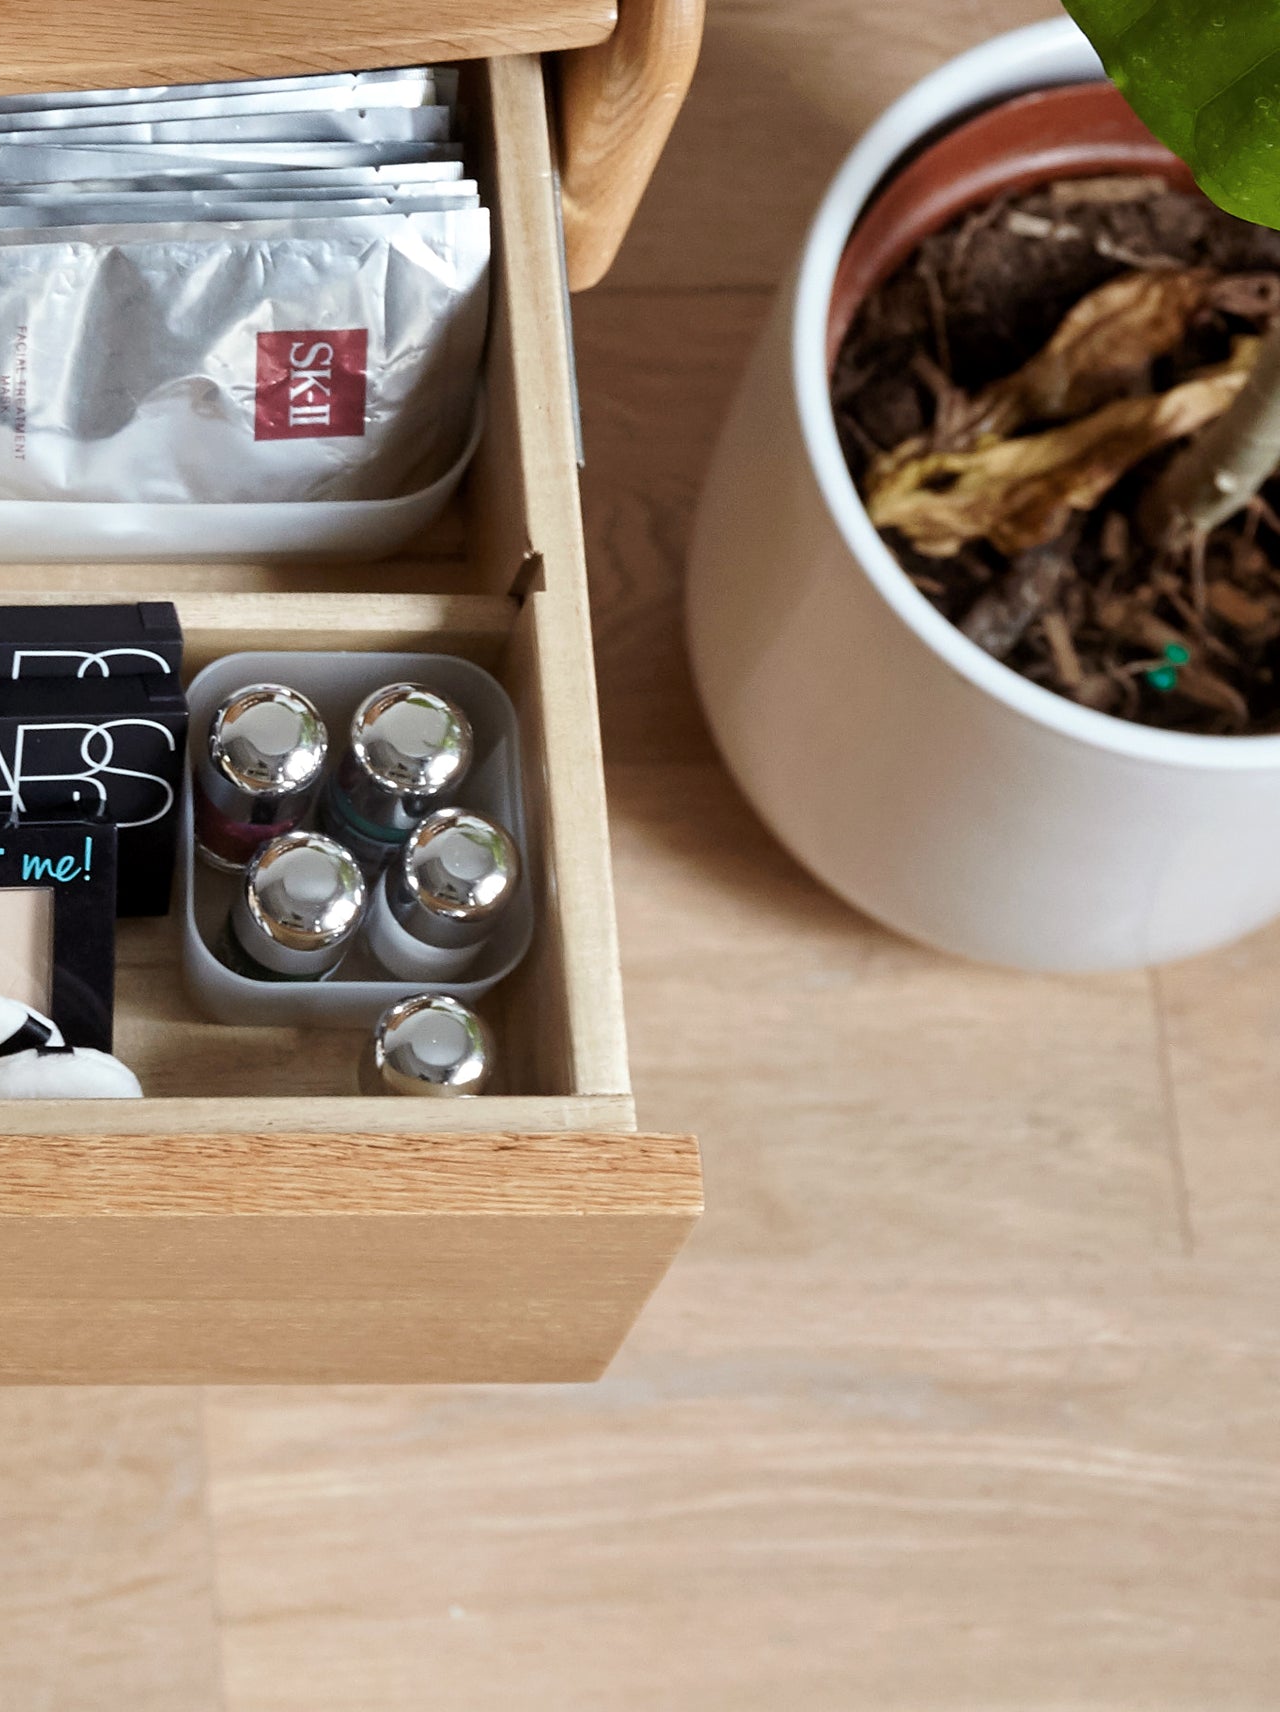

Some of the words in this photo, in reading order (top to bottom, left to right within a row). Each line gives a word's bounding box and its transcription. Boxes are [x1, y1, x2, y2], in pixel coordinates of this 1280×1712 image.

[15, 324, 28, 374] FACIAL
[0, 375, 11, 414] MASK
[288, 340, 334, 429] SK-II
[13, 380, 28, 462] TREATMENT
[21, 836, 94, 883] me!
